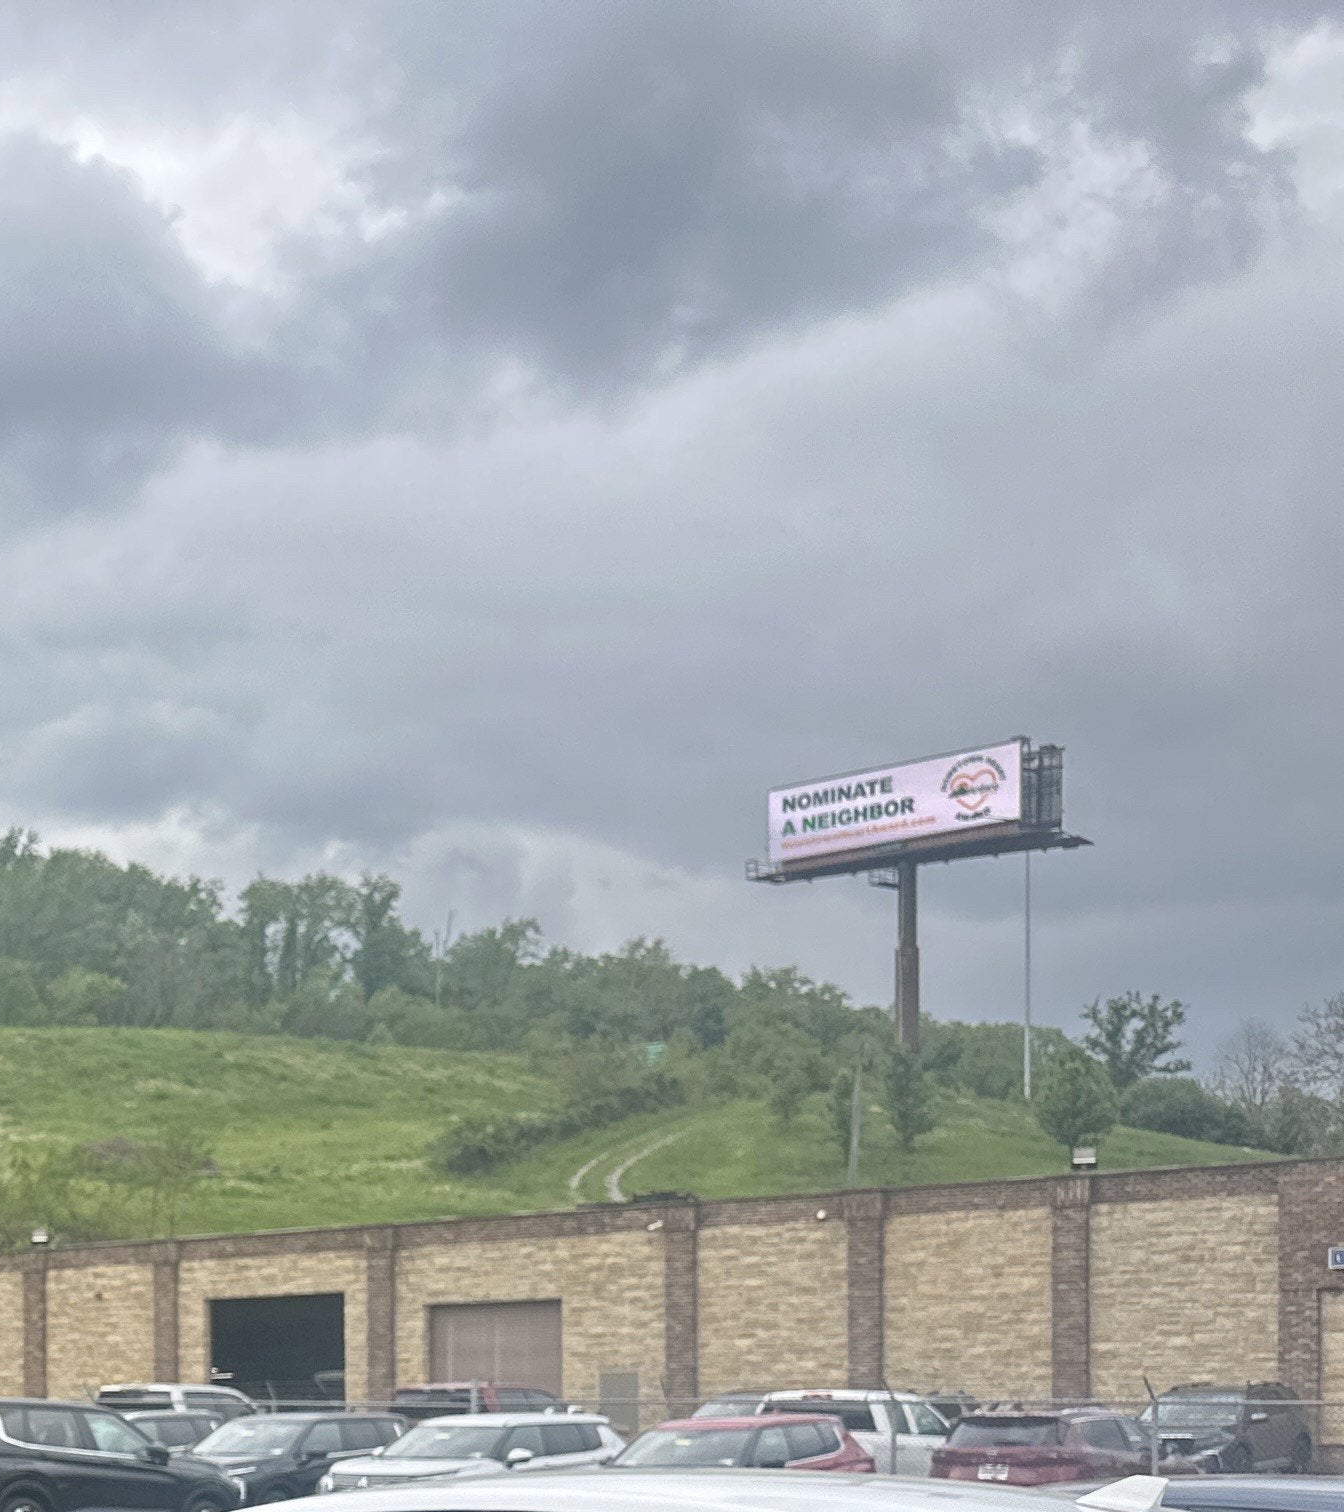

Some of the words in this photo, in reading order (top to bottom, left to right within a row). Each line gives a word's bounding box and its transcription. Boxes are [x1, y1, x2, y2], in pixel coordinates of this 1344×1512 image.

[782, 776, 893, 813] NOMINATE
[782, 818, 796, 837] A
[802, 796, 915, 832] NEIGHBOR
